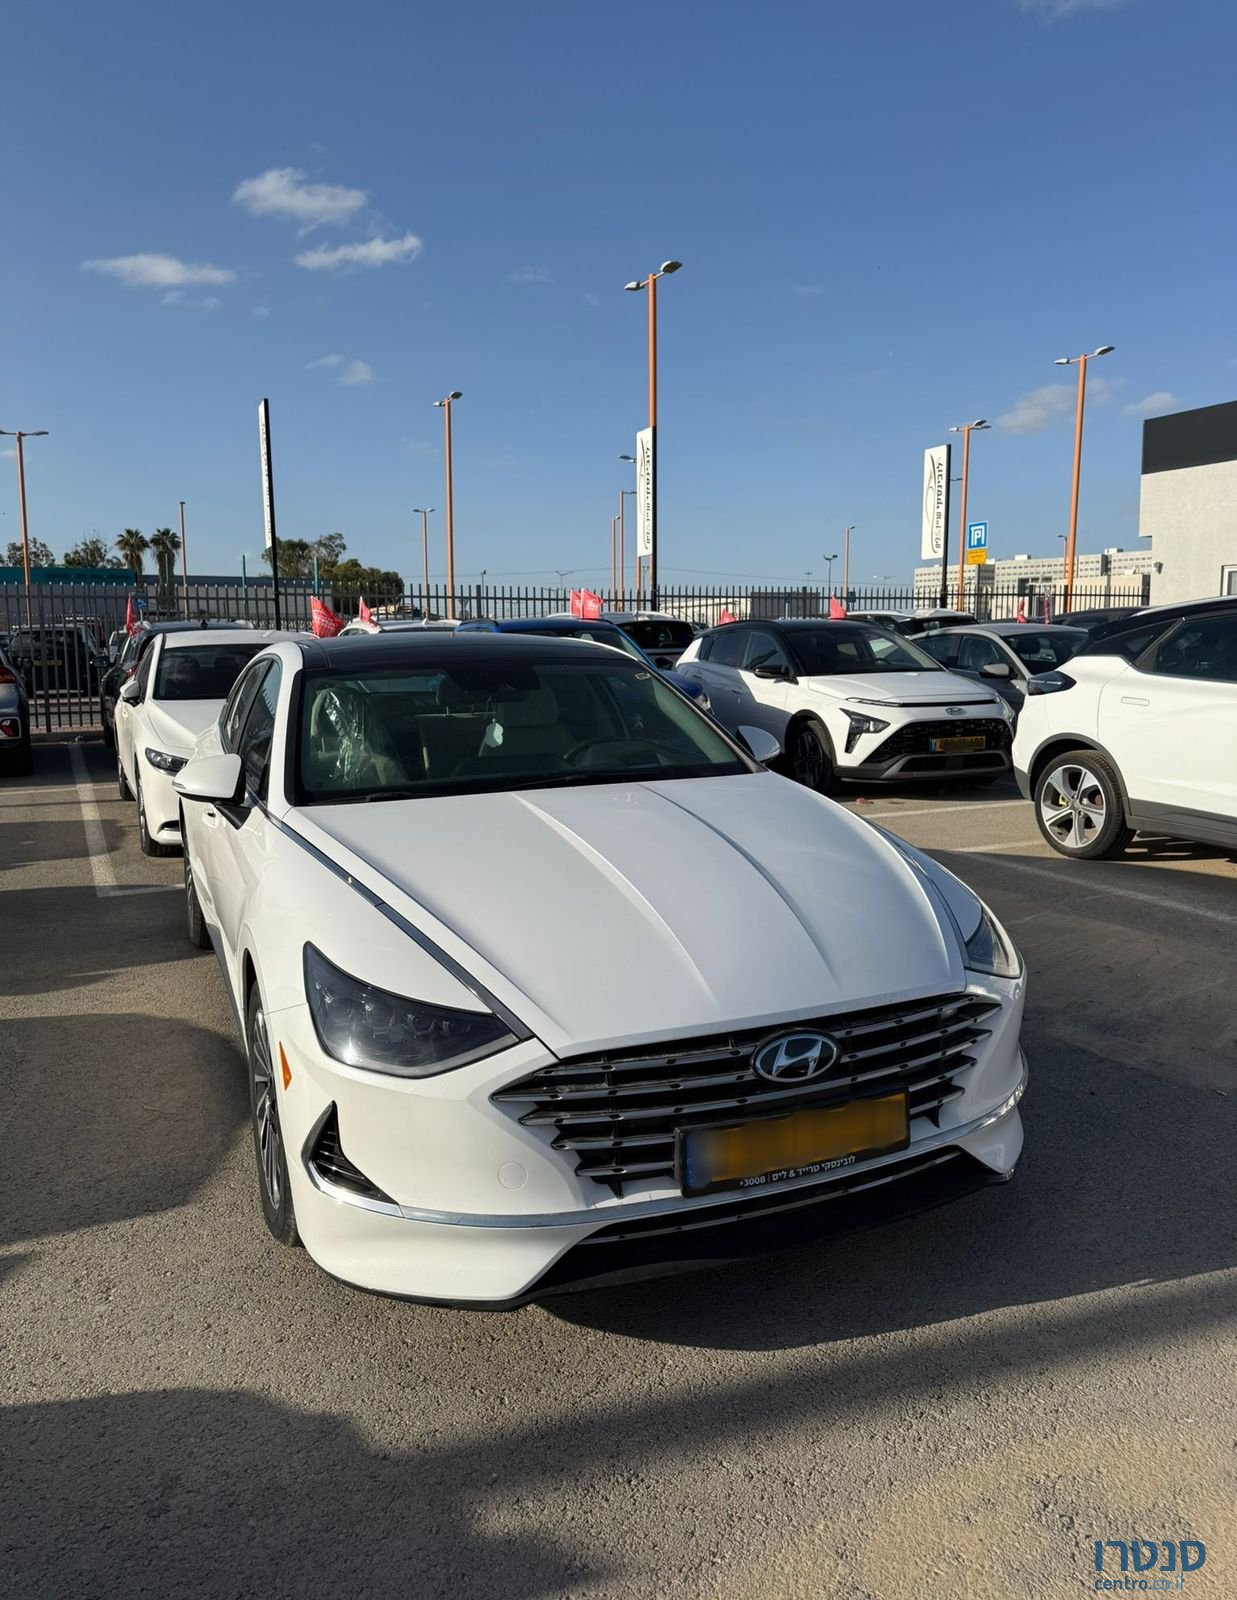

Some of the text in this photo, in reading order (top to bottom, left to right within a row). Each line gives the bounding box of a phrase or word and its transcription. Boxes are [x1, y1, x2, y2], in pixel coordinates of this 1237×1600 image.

[822, 1155, 856, 1172] לובינסקי
[772, 1171, 787, 1181] ליס
[788, 1170, 796, 1178] &
[797, 1164, 820, 1177] טרייד
